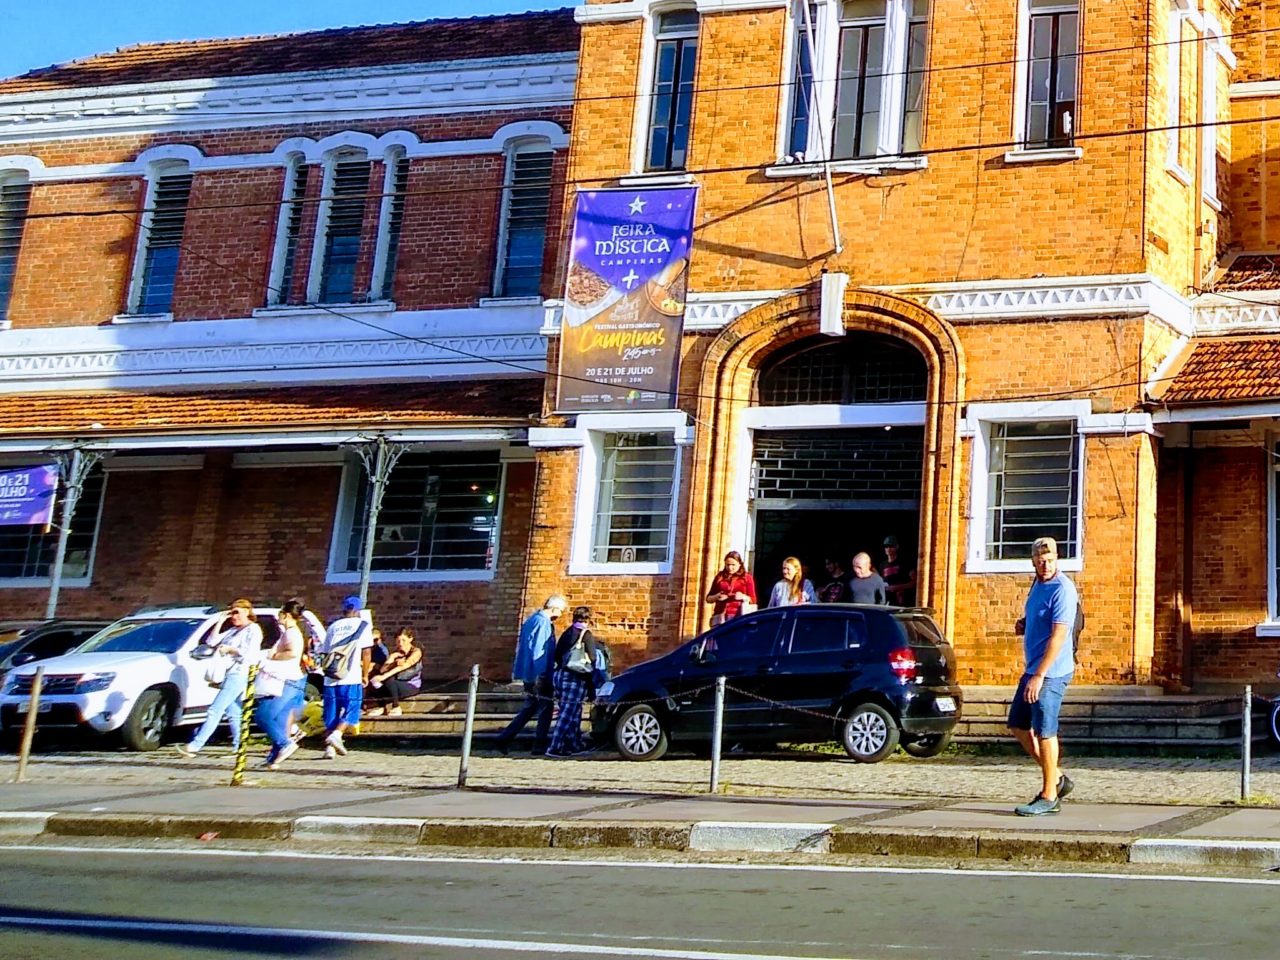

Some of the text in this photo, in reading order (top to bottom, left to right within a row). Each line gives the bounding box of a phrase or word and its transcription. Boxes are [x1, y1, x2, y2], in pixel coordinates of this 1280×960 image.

[612, 224, 656, 241] FEIRA
[600, 257, 663, 266] CAMPINAS
[579, 327, 666, 357] Campinas
[585, 366, 654, 377] 20 E 21 DE JULHO
[15, 473, 30, 486] 21
